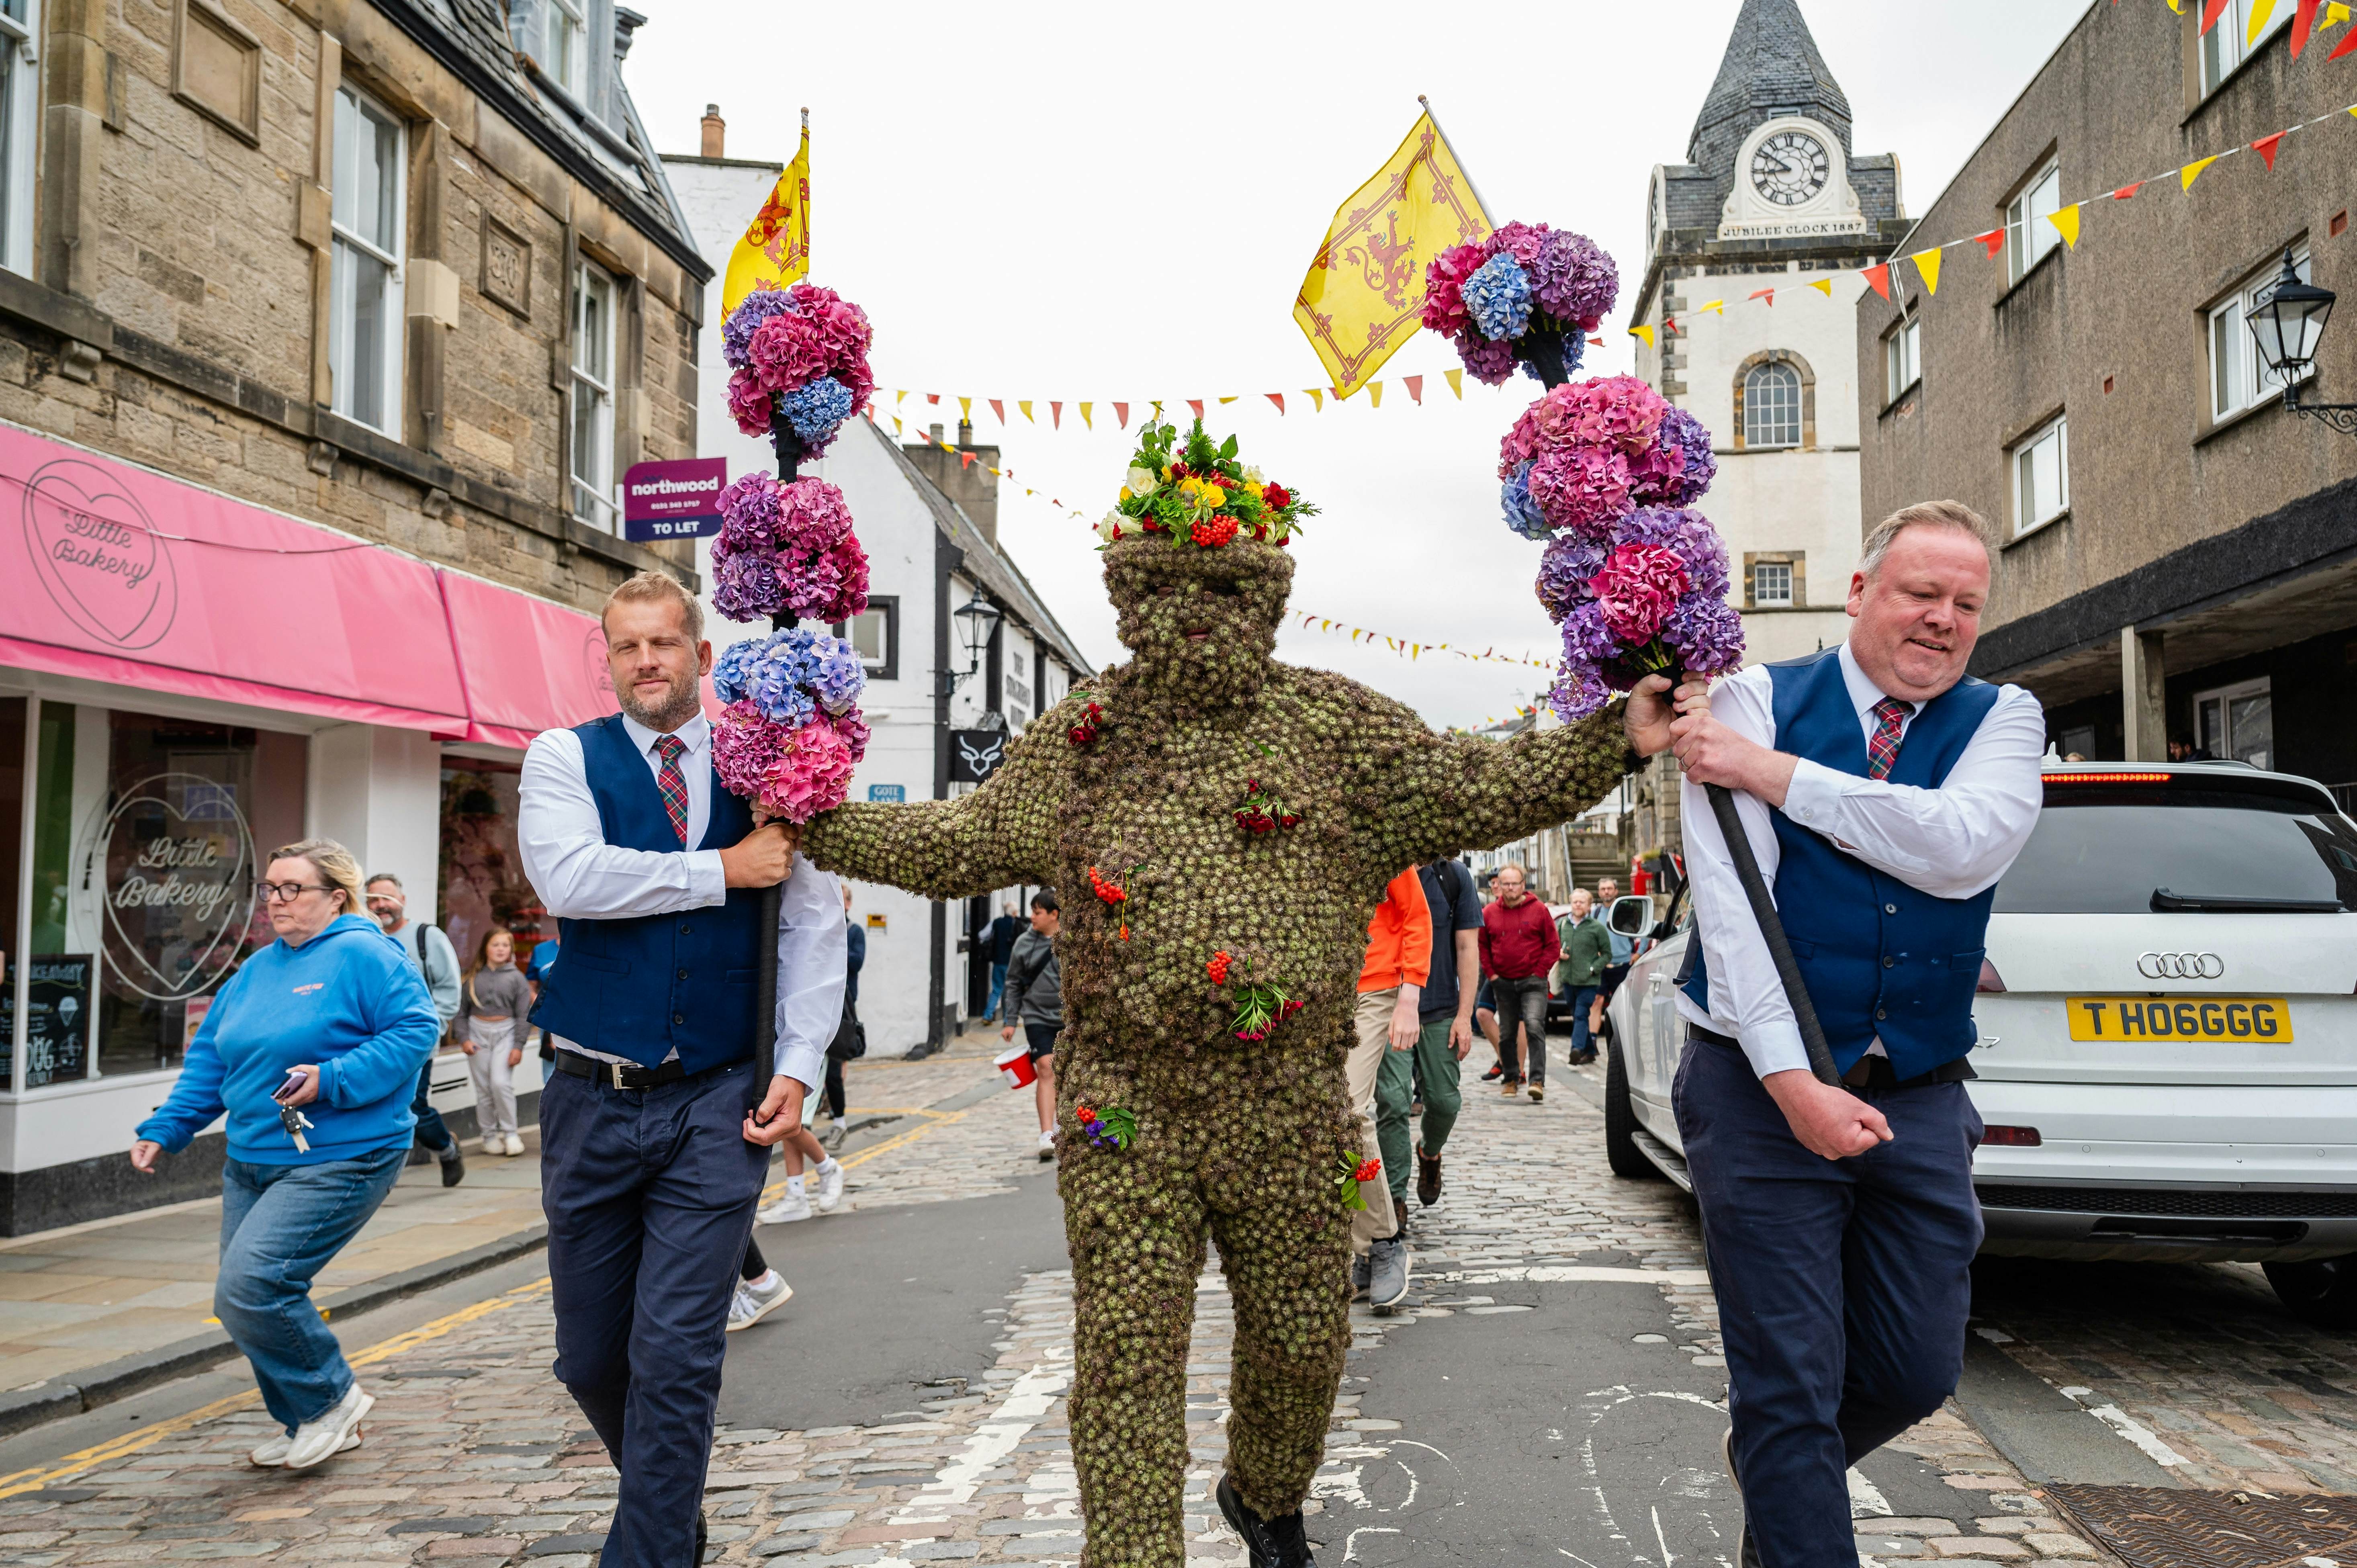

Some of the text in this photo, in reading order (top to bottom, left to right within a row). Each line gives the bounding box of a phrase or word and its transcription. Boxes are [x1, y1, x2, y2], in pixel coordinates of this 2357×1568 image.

[1723, 222, 1862, 237] JUBILEE CLOCK 1887
[632, 476, 718, 496] northwood
[64, 513, 132, 548] Little
[652, 521, 700, 535] TO LET
[53, 539, 145, 589] Bakery
[874, 786, 900, 796] GOTE
[138, 836, 218, 868] Little
[115, 872, 226, 922] Bakery
